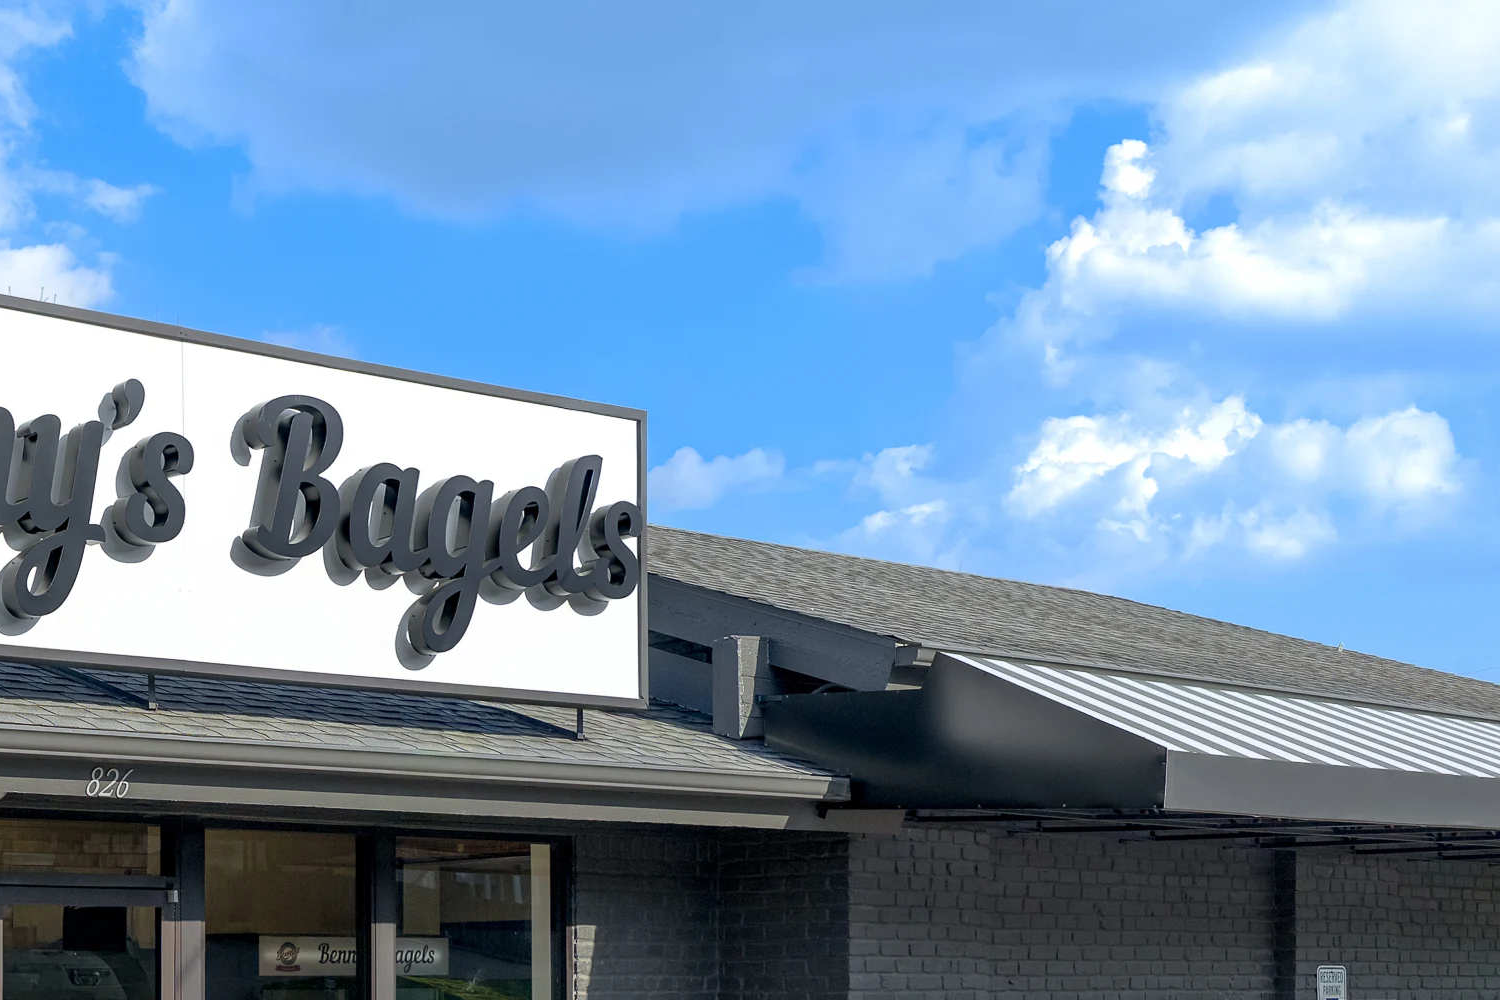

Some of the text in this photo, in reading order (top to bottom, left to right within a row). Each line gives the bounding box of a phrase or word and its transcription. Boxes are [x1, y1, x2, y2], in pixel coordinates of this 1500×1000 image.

[240, 395, 641, 656] Bagels
[86, 766, 134, 798] 826
[318, 942, 357, 964] Benn
[396, 944, 435, 973] agels
[1320, 971, 1343, 983] RESERVED
[1323, 985, 1341, 996] PARKING
